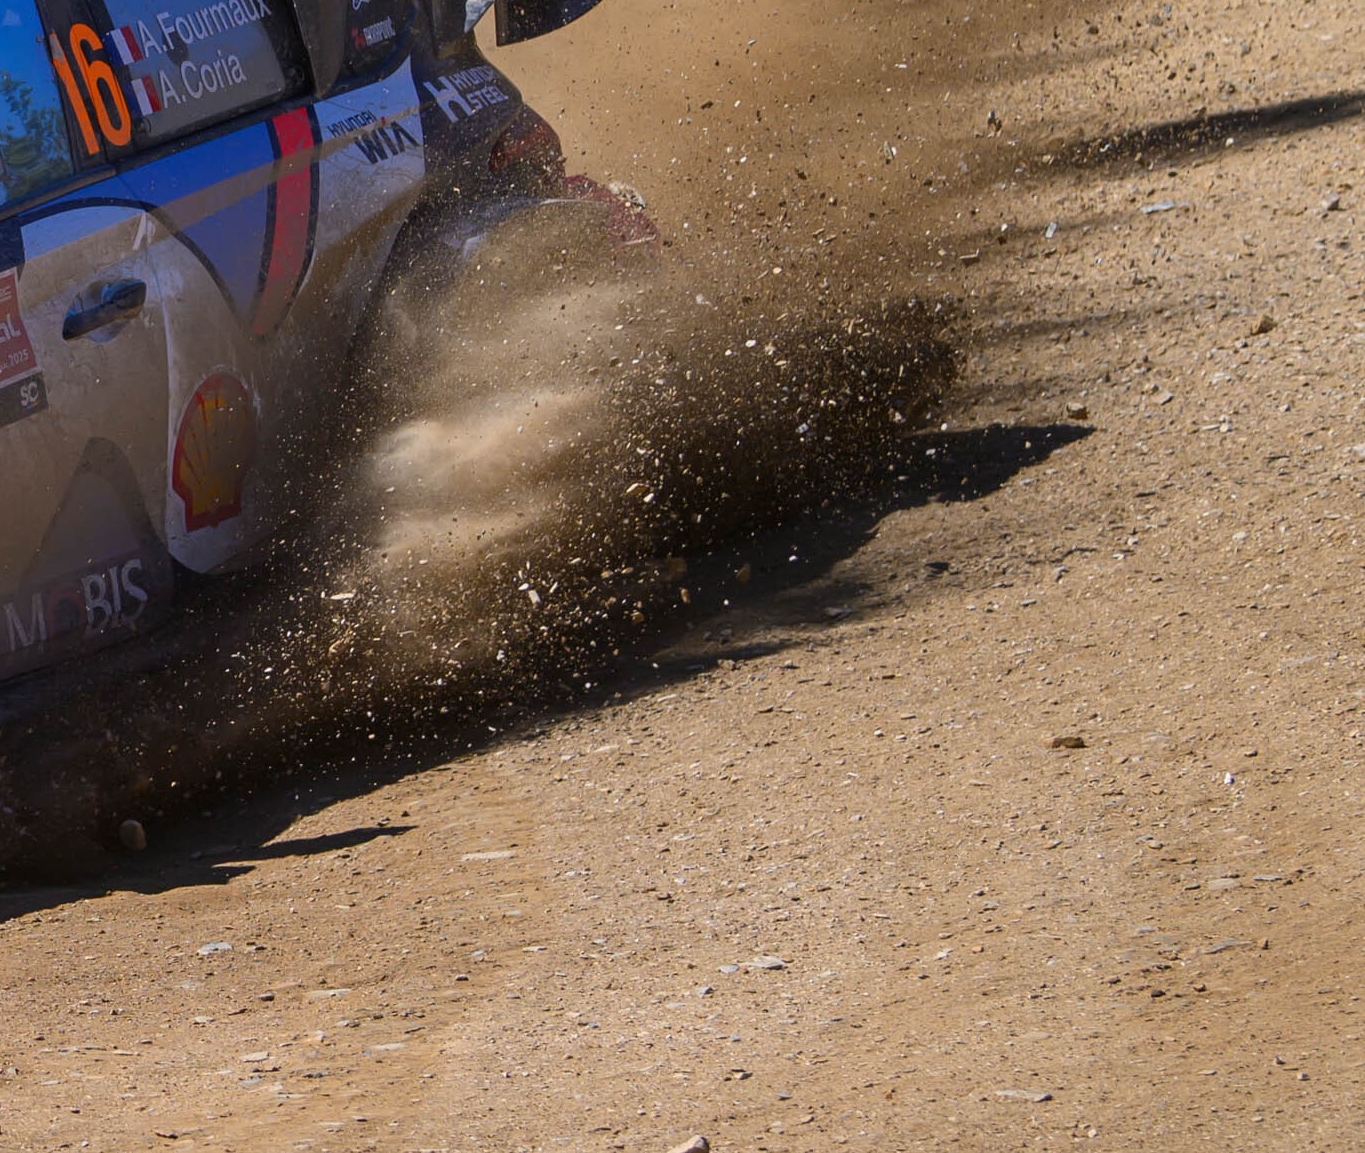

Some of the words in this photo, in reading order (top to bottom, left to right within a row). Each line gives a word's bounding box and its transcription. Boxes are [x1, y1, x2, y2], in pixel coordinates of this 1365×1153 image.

[49, 22, 132, 155] 16
[468, 86, 510, 112] STEEL
[327, 109, 378, 138] HYUNDAI
[8, 348, 29, 366] 2025
[20, 381, 39, 407] SC
